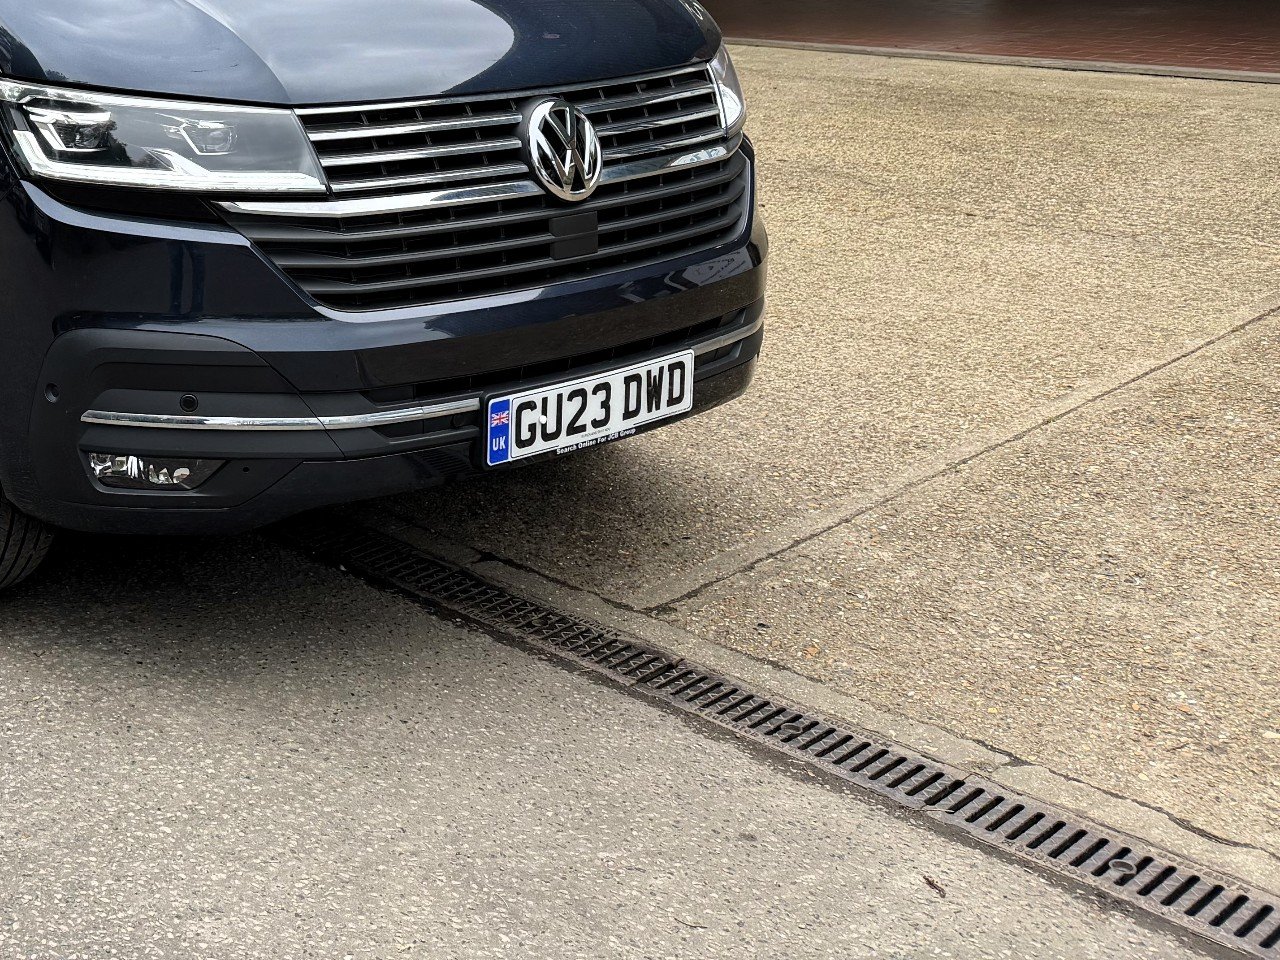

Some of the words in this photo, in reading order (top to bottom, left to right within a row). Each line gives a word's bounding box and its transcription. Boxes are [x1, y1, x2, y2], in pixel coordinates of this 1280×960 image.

[515, 381, 612, 449] GU23
[622, 360, 686, 421] DWD
[492, 435, 506, 452] UK
[556, 445, 577, 455] Search
[578, 439, 597, 449] Online
[597, 436, 607, 444] For
[619, 428, 636, 437] Group
